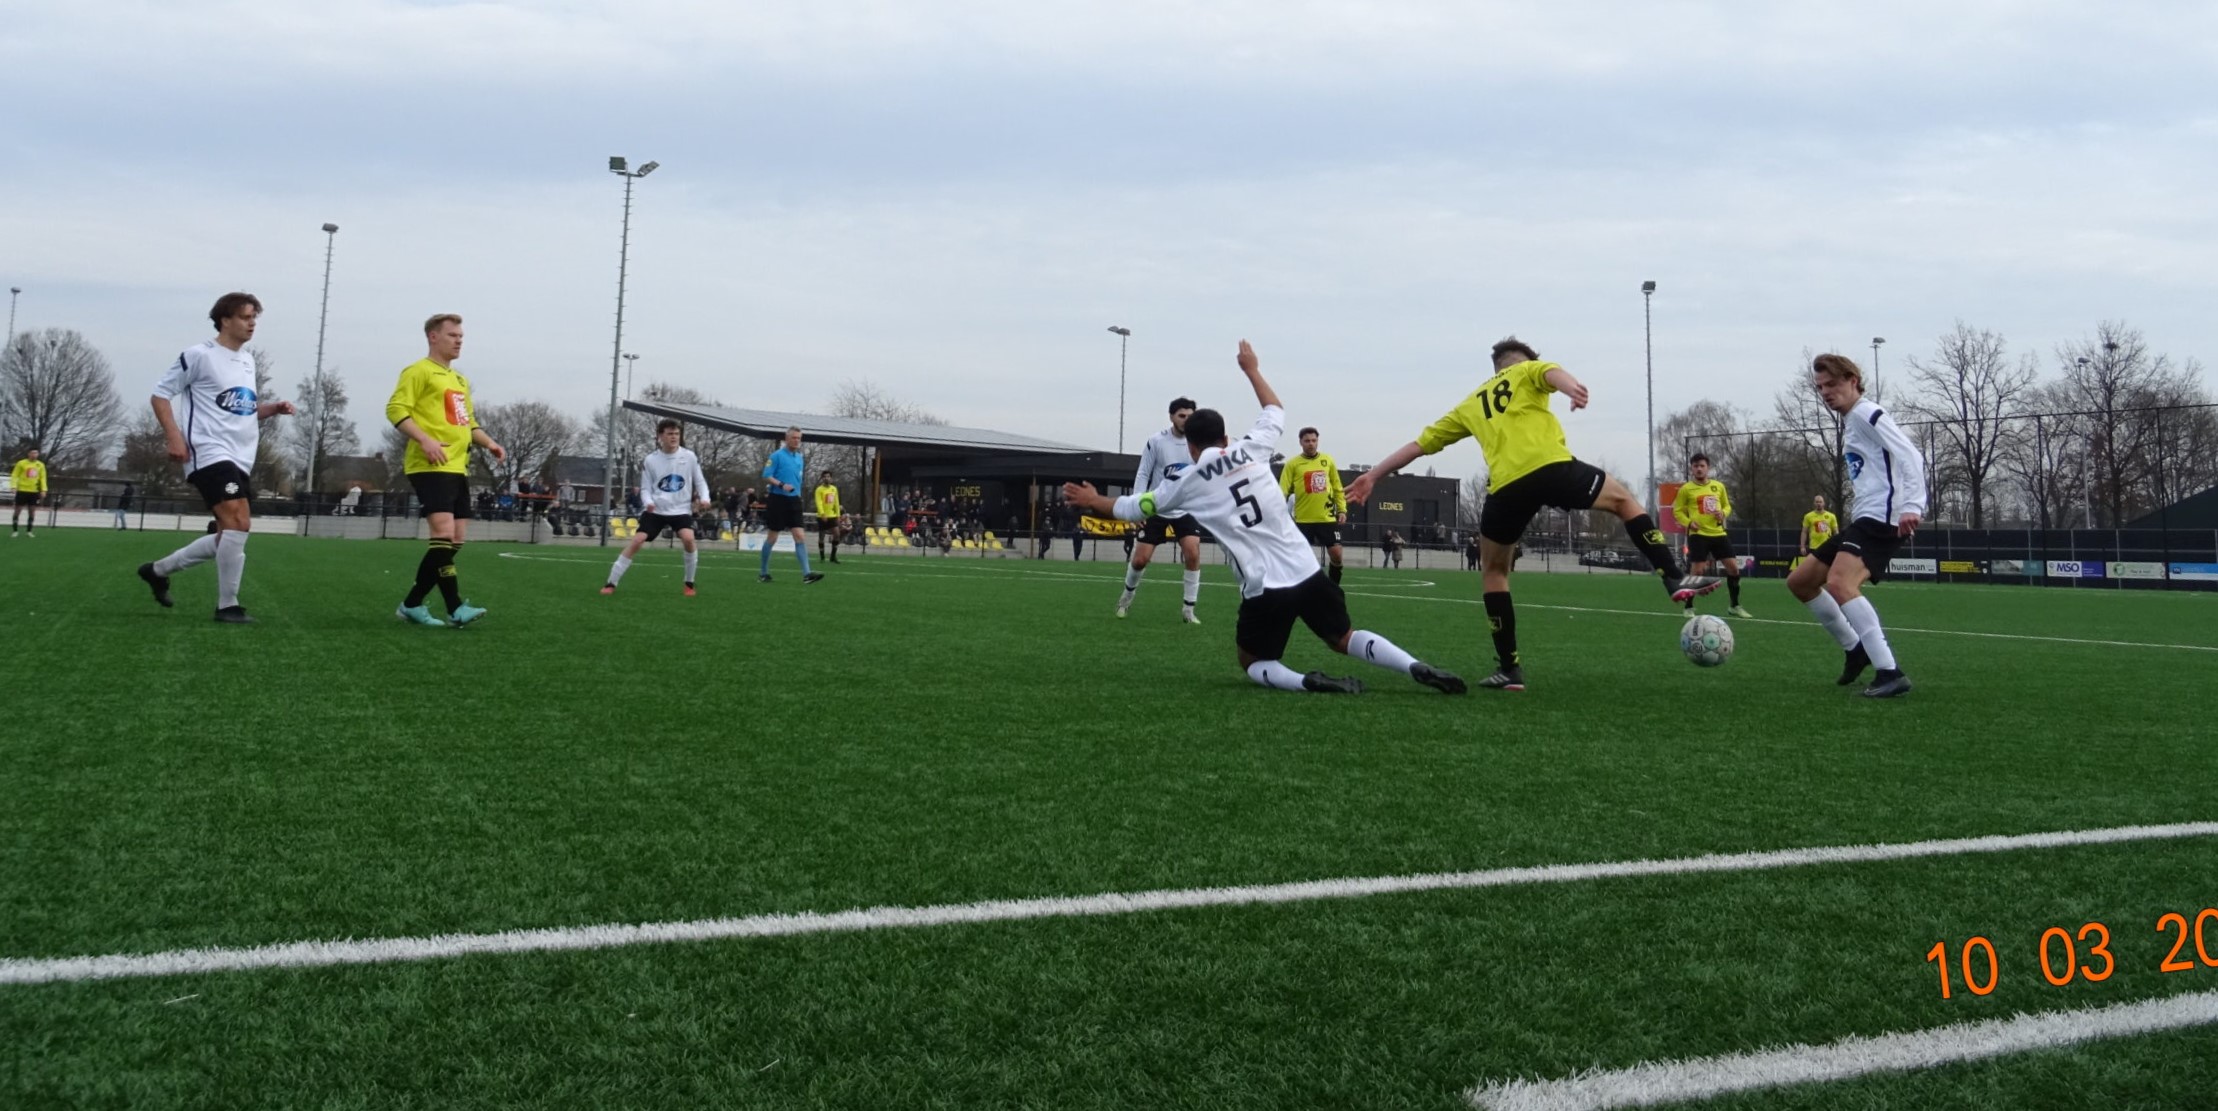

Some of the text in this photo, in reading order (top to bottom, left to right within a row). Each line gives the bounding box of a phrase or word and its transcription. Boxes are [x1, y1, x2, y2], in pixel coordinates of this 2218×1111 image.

[1476, 379, 1513, 419] 18
[1197, 448, 1254, 481] WIKA
[951, 486, 981, 497] LEONES
[1229, 478, 1262, 528] 5
[1379, 502, 1404, 511] LEONES
[1891, 561, 1926, 571] huisman
[2056, 563, 2080, 573] MSO
